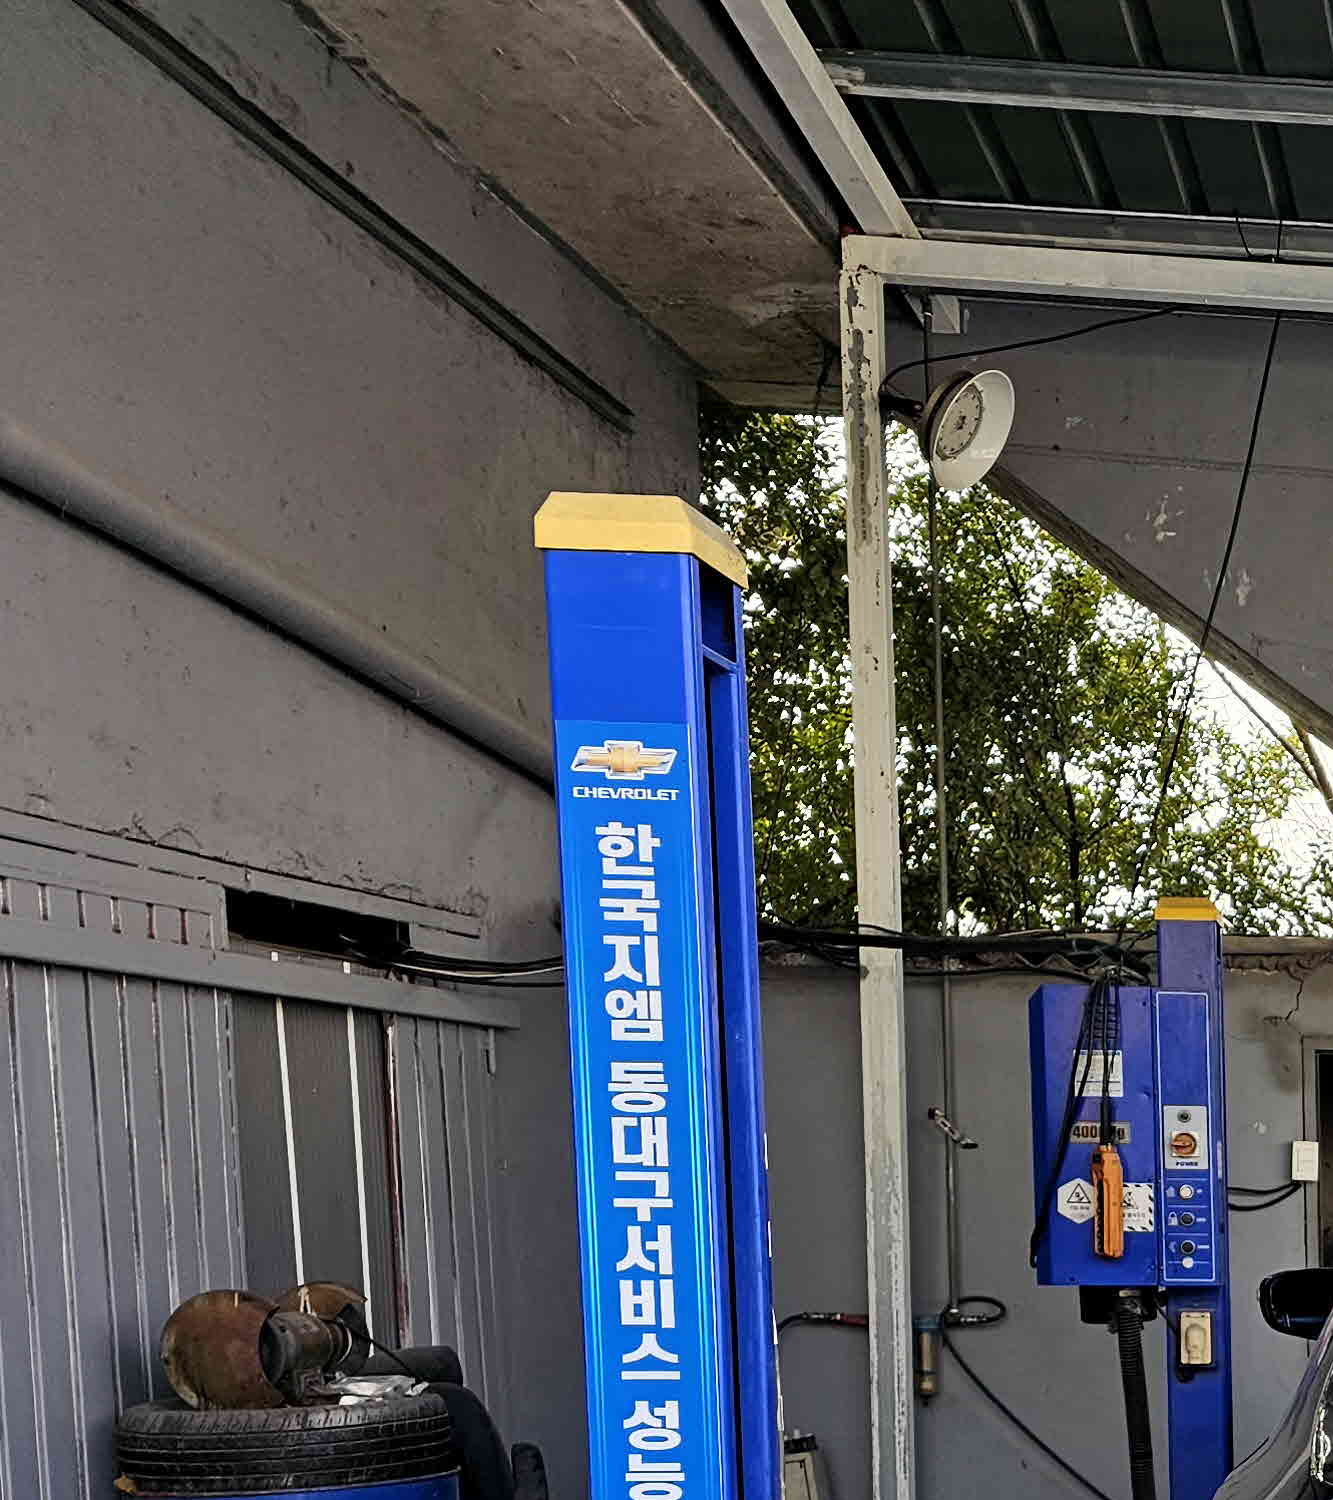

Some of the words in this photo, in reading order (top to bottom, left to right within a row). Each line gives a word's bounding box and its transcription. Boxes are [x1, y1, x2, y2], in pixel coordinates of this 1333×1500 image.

[573, 785, 680, 801] CHEVROLET
[595, 821, 665, 1042] 한국지엠
[607, 1061, 682, 1381] 동대구서비스
